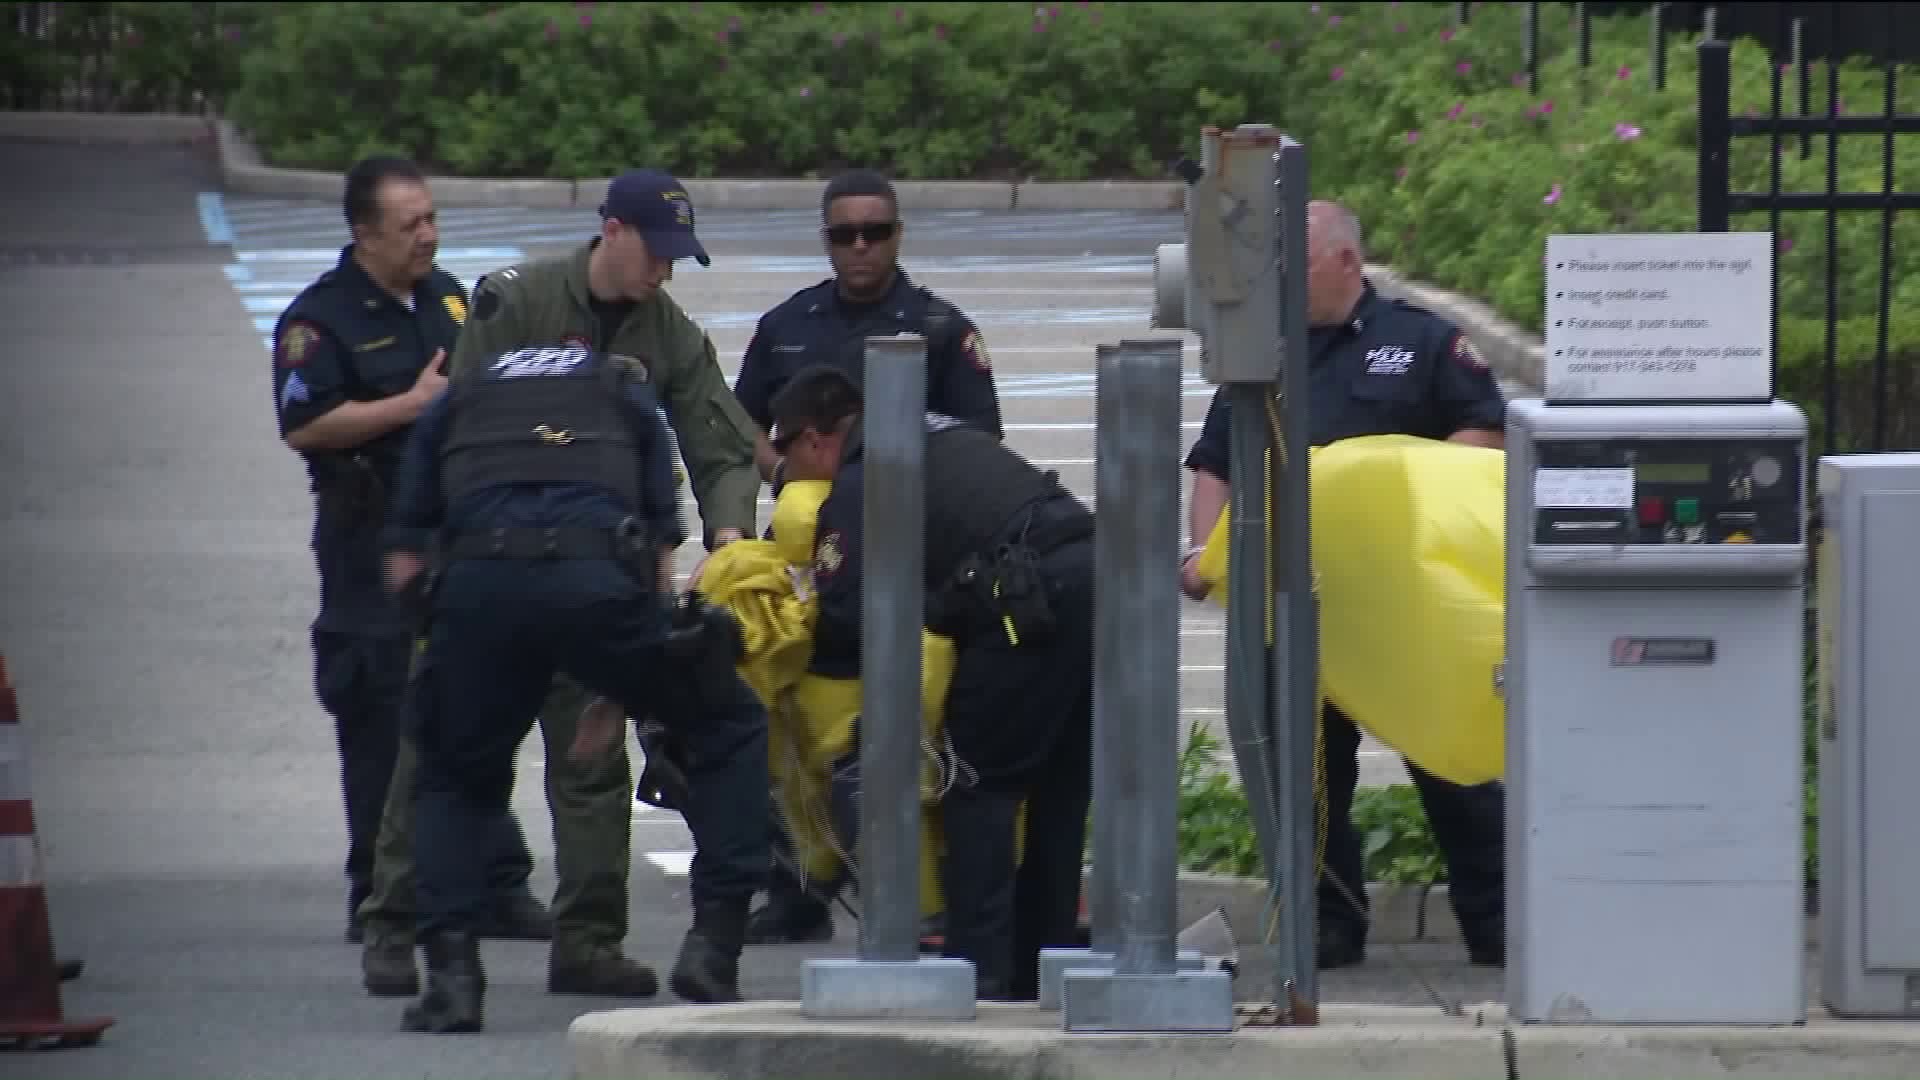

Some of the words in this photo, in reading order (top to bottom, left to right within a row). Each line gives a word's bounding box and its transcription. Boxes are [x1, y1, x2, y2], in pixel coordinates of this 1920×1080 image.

[1568, 259, 1609, 272] Please
[1612, 259, 1646, 271] insert
[1649, 259, 1680, 271] ticket
[1683, 259, 1705, 271] into
[1707, 259, 1726, 271] the
[1604, 288, 1639, 300] credit
[1638, 318, 1668, 331] push
[488, 347, 588, 369] JCPD
[1365, 349, 1415, 363] POLICE
[1567, 345, 1589, 357] For
[1590, 345, 1654, 357] assistance
[1655, 345, 1682, 357] after
[1685, 345, 1720, 357] hours
[1721, 345, 1764, 359] please
[1567, 361, 1612, 373] contact
